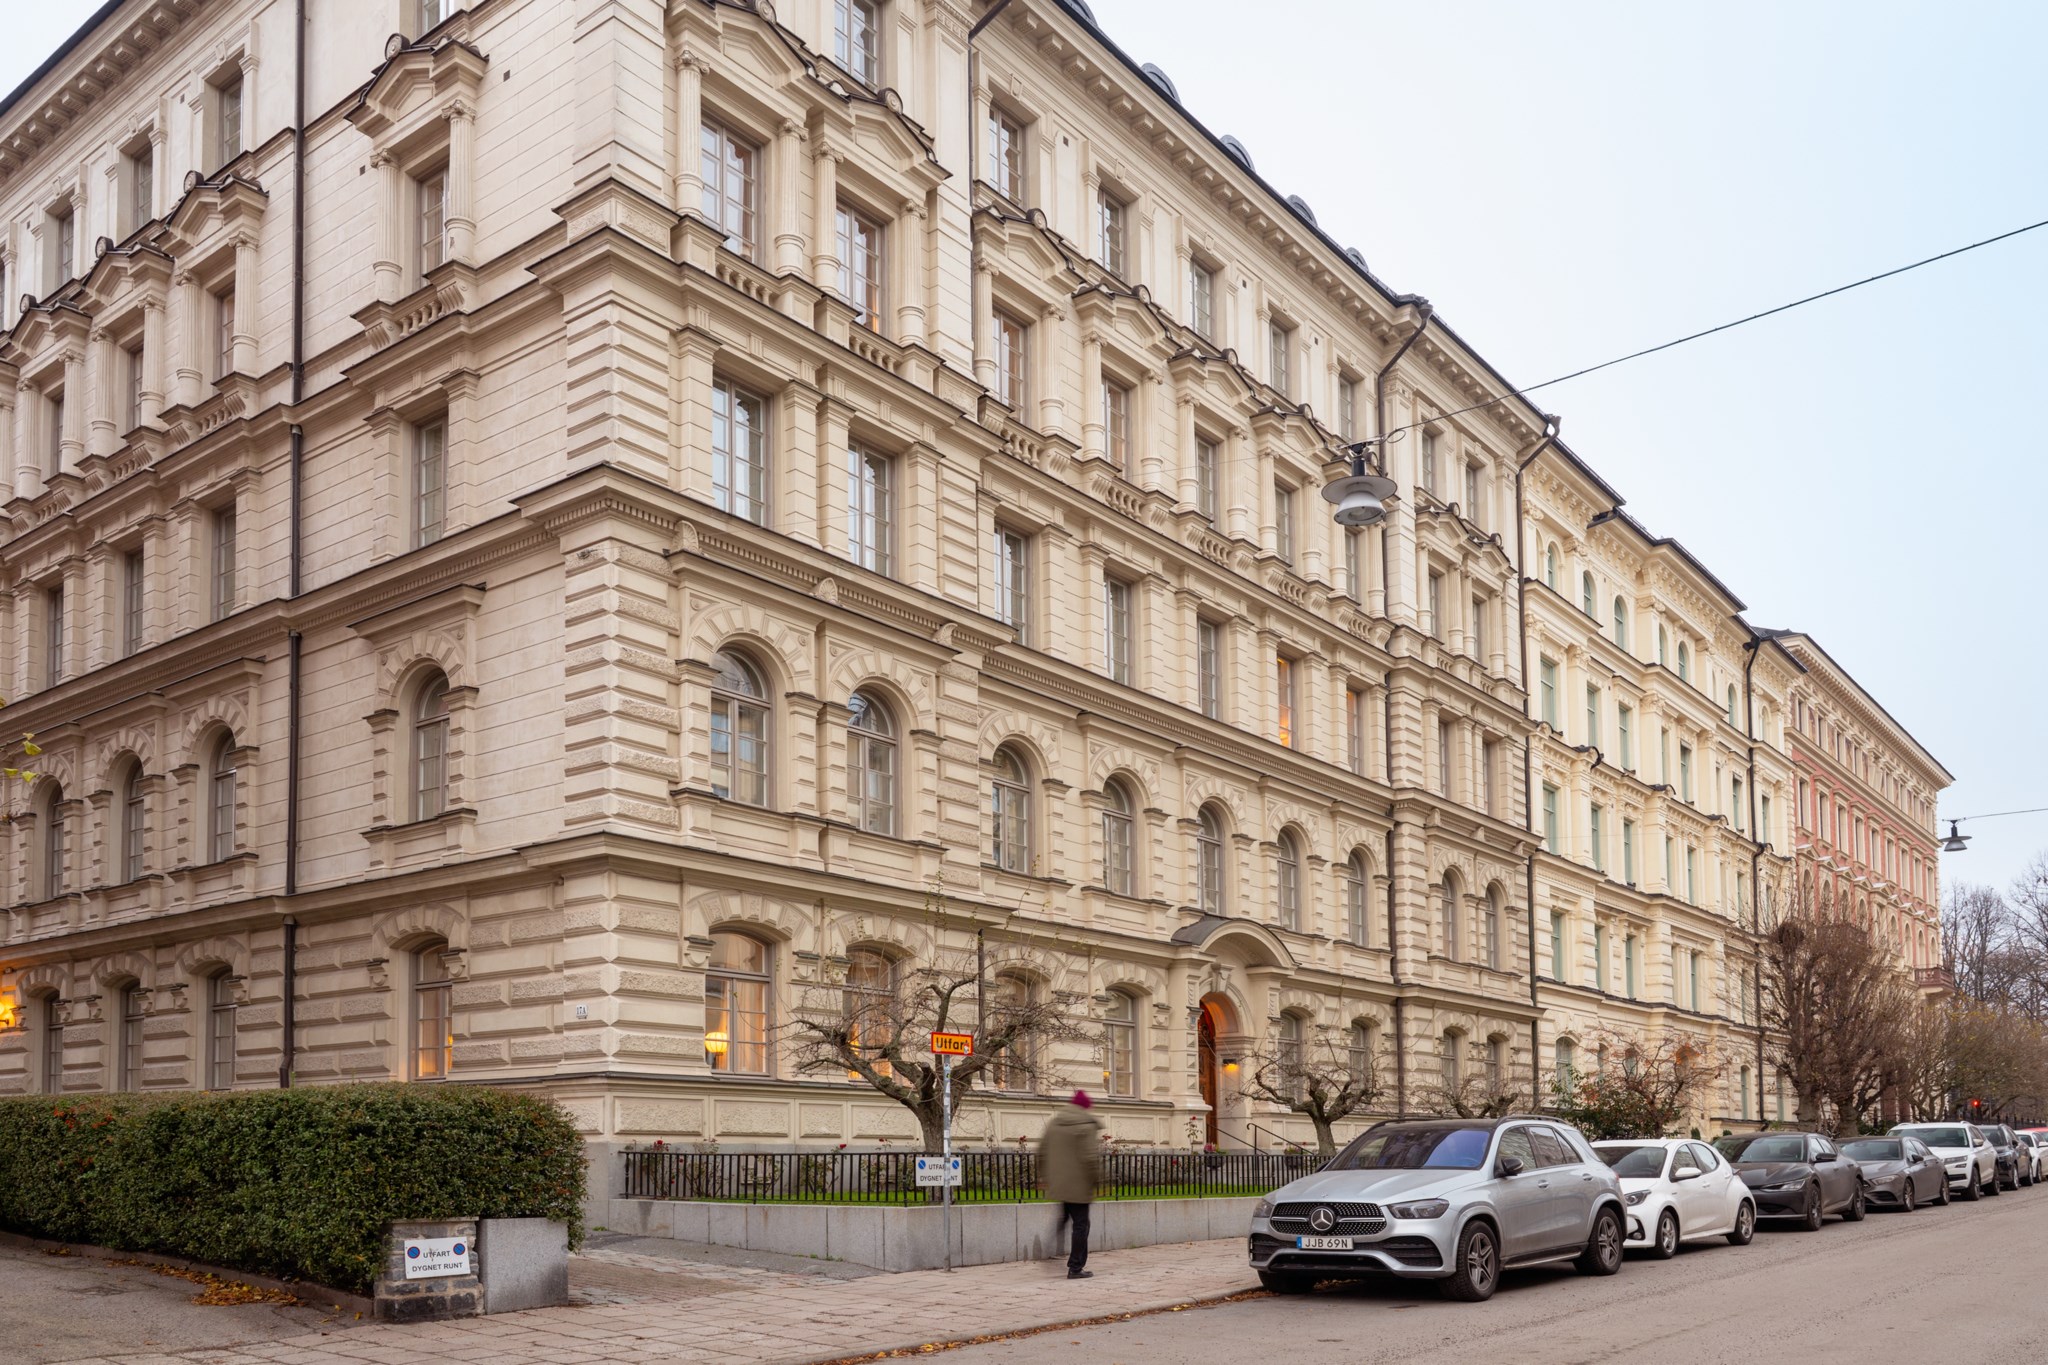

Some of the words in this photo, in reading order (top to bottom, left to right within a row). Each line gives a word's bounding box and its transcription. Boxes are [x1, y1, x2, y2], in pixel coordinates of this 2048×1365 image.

[1305, 1238, 1324, 1248] JJB
[1326, 1238, 1348, 1248] 69N
[423, 1250, 450, 1259] UTFART
[412, 1263, 442, 1272] DYGNET
